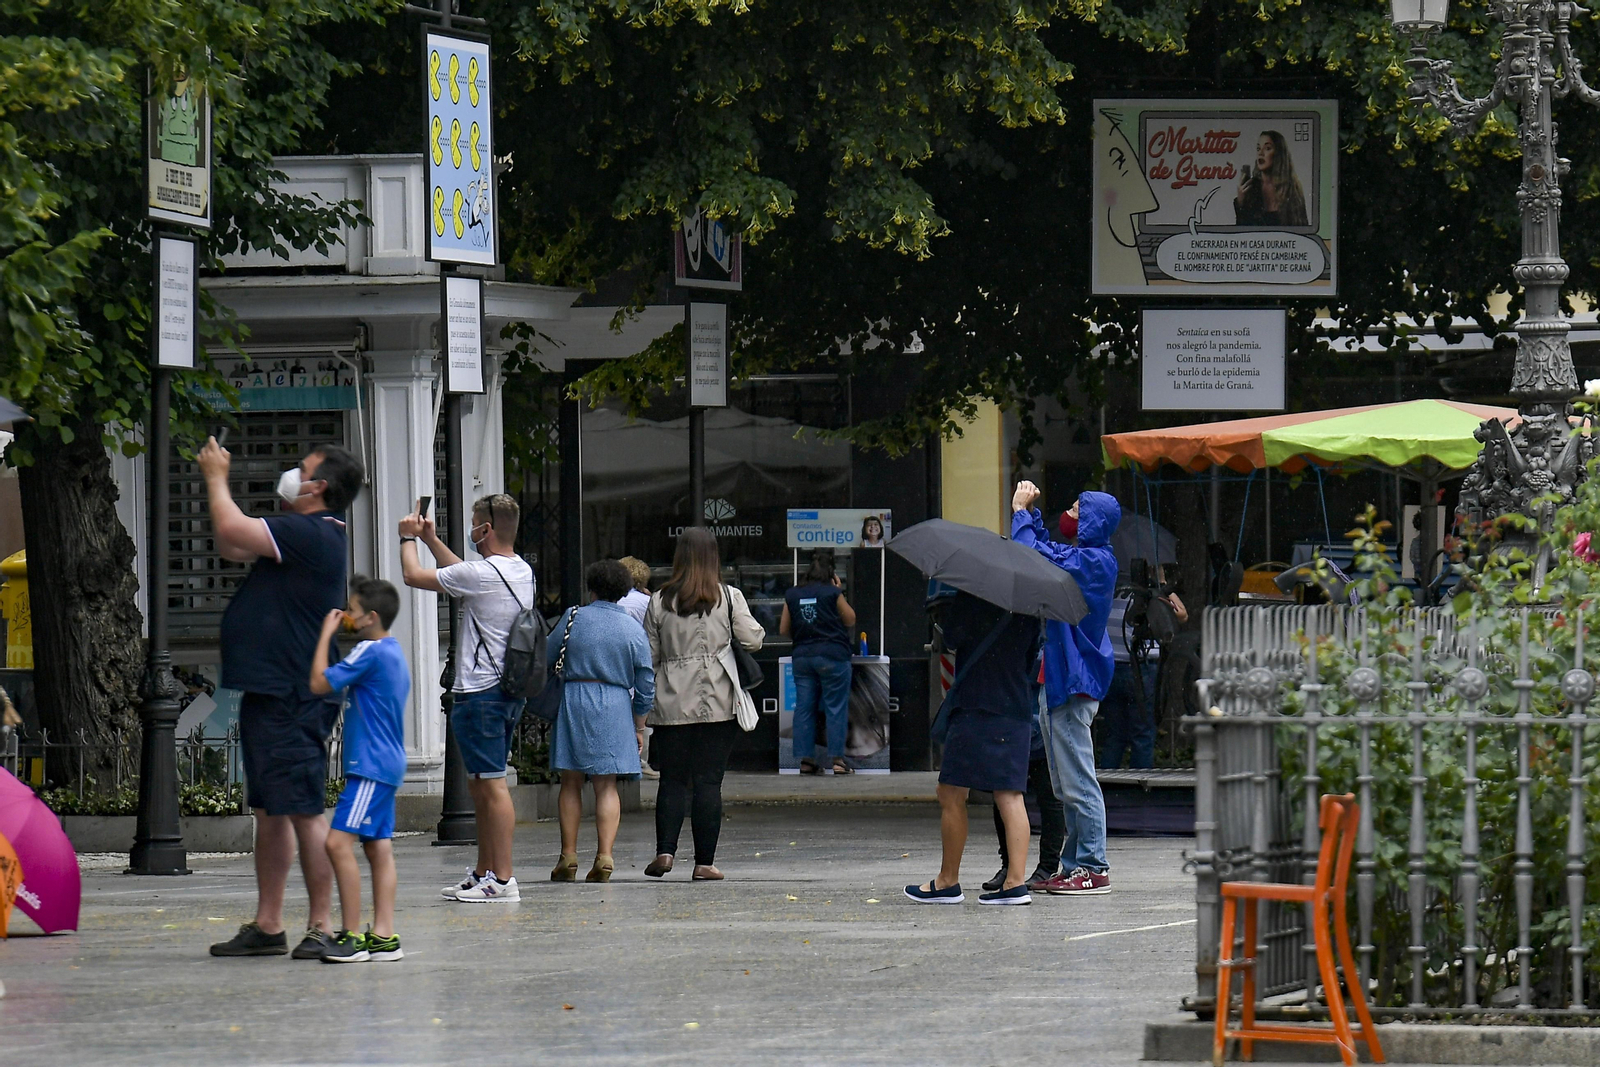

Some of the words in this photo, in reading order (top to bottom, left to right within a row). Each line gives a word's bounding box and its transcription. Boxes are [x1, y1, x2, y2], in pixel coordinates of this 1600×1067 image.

[1148, 126, 1241, 158] Martita
[1149, 159, 1173, 179] de
[1191, 240, 1229, 248] ENCERRADA
[1230, 240, 1239, 248] EN
[1240, 240, 1247, 248] MI
[1249, 240, 1264, 248] CASA
[1266, 240, 1296, 248] DURANTE
[1178, 252, 1185, 260] EL
[1187, 252, 1238, 260] CONFINAMIENTO
[1240, 250, 1259, 260] PENSÉ
[1261, 252, 1270, 260] EN
[1271, 252, 1308, 260] CAMBIARME
[1174, 264, 1182, 272] EL
[1184, 264, 1210, 272] NOMBRE
[1212, 264, 1225, 272] POR
[1226, 264, 1234, 272] EL
[1236, 264, 1244, 272] DE
[1246, 264, 1278, 272] "JARTITA"
[1280, 264, 1288, 272] DE
[1290, 262, 1312, 272] GRANÁ
[1177, 328, 1208, 336] Sentaíca
[1234, 327, 1250, 336] sofá
[1182, 340, 1208, 352] alegró
[1210, 340, 1216, 350] la
[1218, 340, 1262, 352] pandemia.
[1176, 354, 1194, 362] Con
[1196, 354, 1211, 362] fina
[1213, 354, 1251, 362] malafollá
[1178, 367, 1200, 376] burló
[1202, 367, 1212, 376] de
[1214, 367, 1220, 376] la
[1222, 367, 1260, 378] epidemia
[1174, 380, 1180, 390] la
[1182, 380, 1212, 390] Martita
[1214, 380, 1224, 390] de
[1226, 380, 1254, 390] Graná.
[797, 528, 854, 544] contigo
